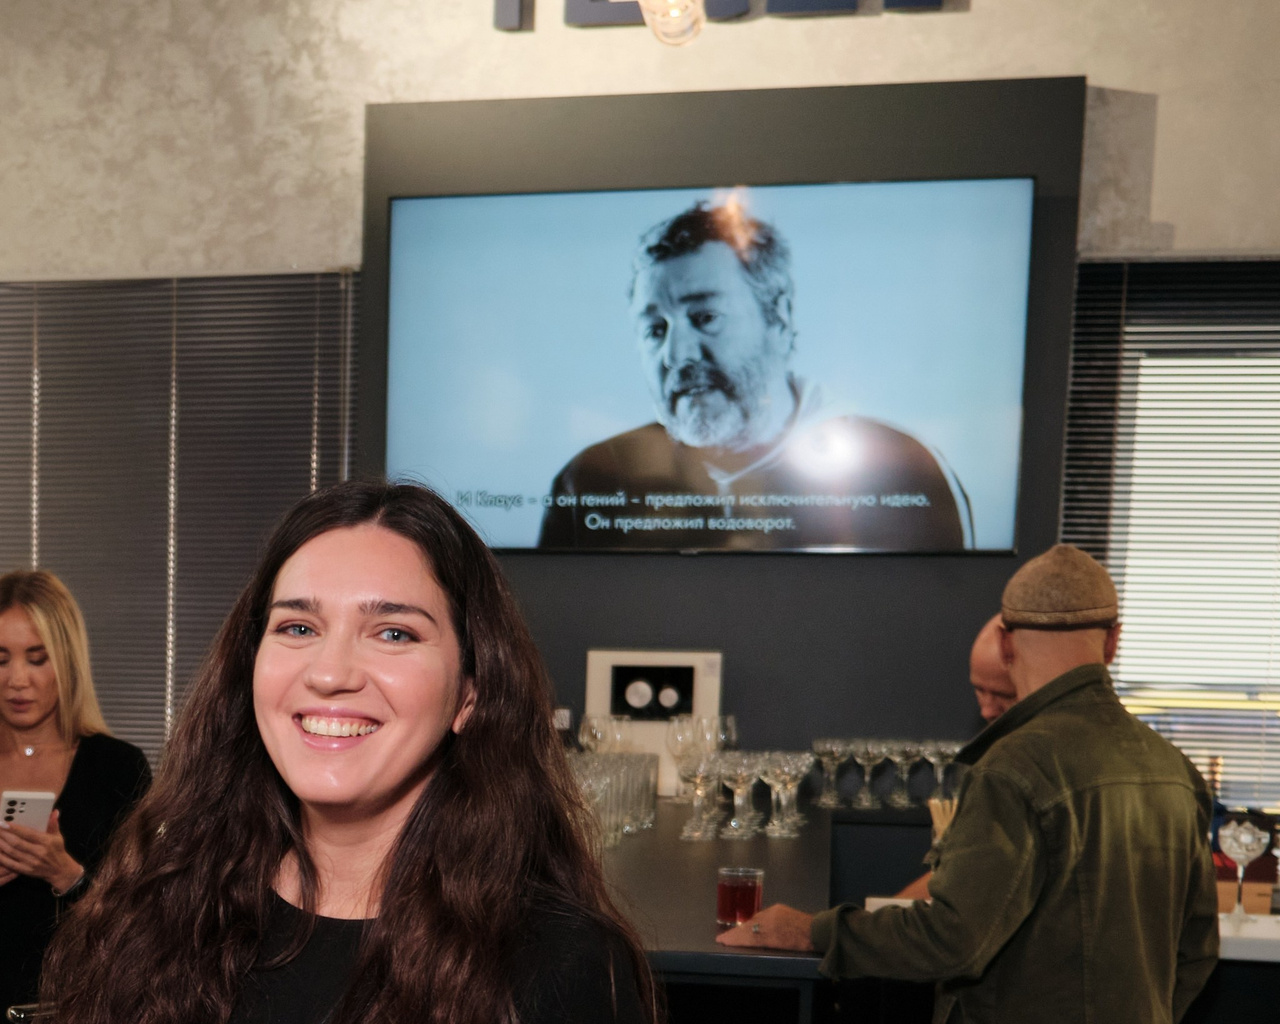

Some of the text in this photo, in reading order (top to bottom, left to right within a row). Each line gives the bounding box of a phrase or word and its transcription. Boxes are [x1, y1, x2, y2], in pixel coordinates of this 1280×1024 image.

[556, 495, 577, 507] он
[580, 491, 625, 507] гений
[645, 494, 735, 510] предложил
[585, 513, 796, 533] Он предложил водоворот.
